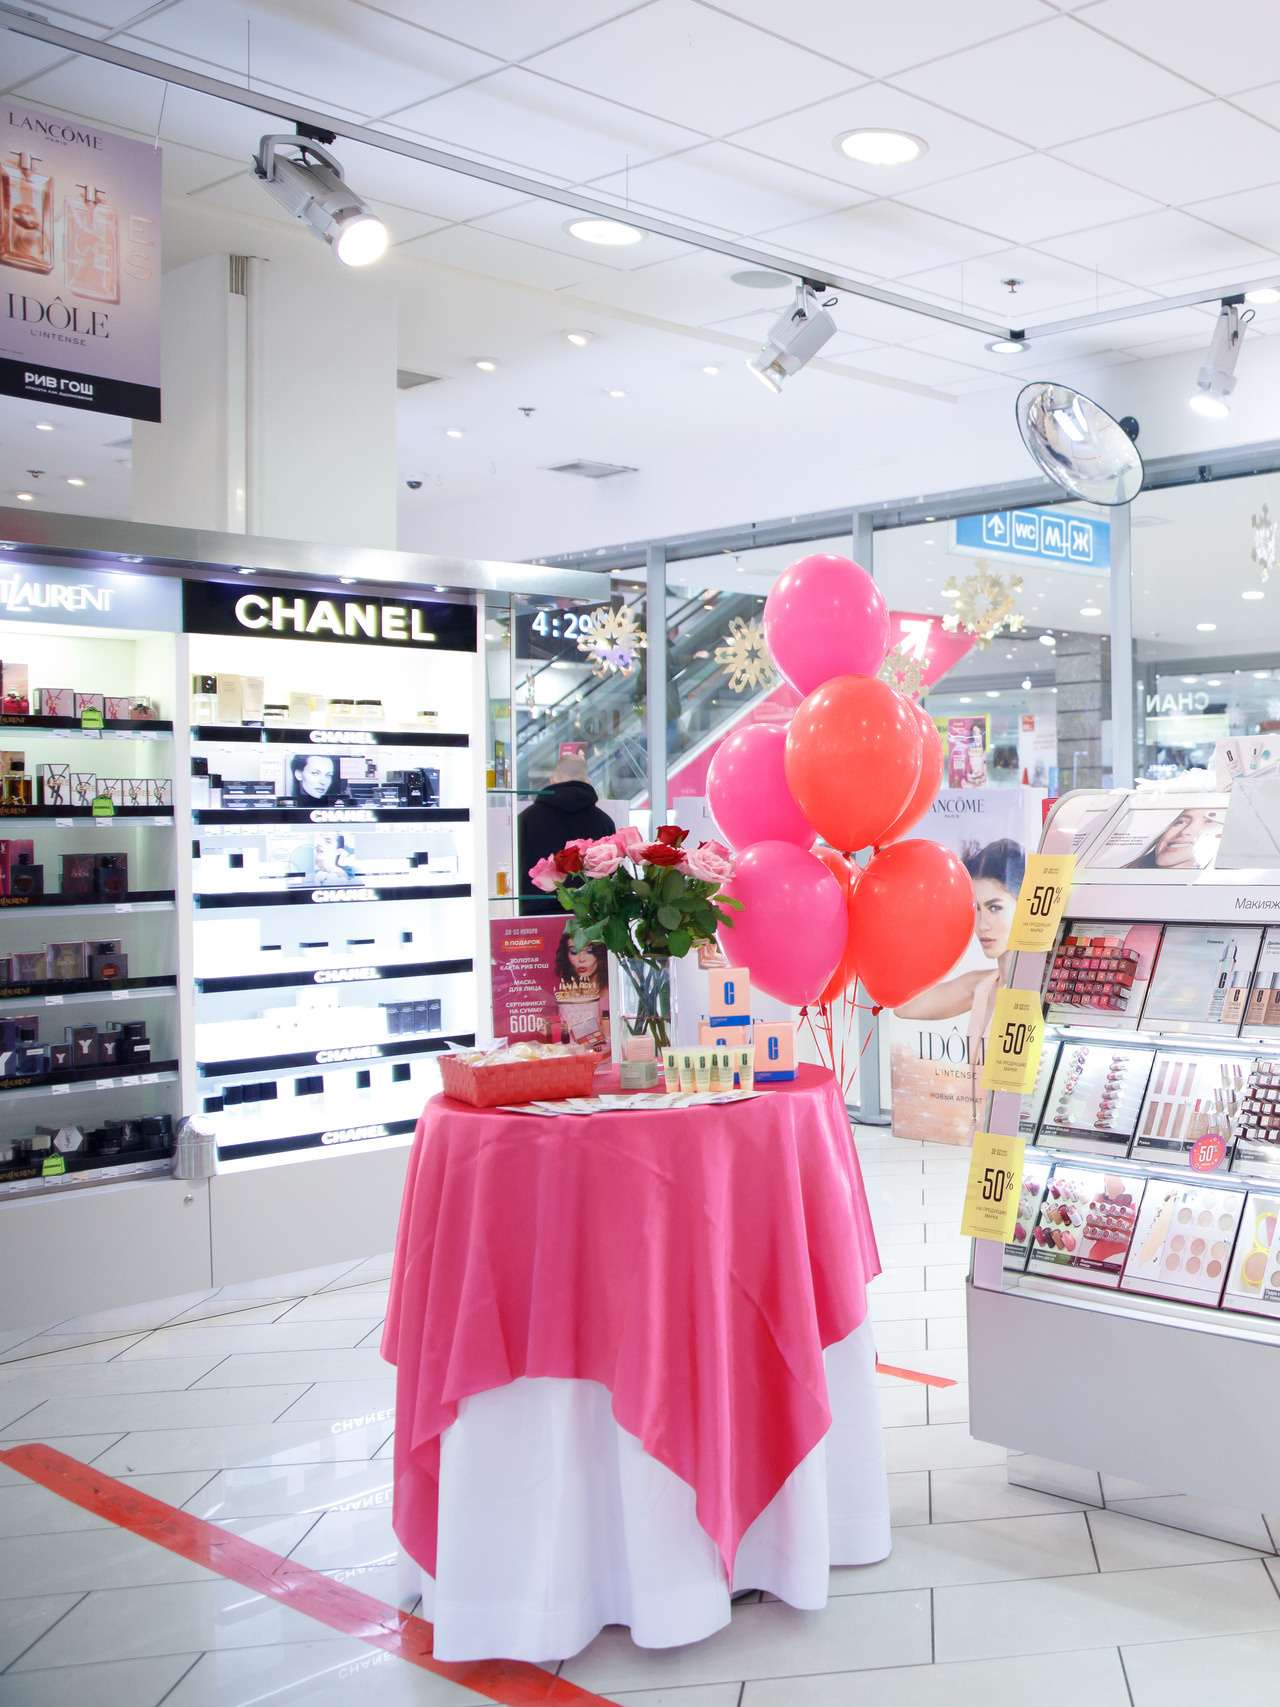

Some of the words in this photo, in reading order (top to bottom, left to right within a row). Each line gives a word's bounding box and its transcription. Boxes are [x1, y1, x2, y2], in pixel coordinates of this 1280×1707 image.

[9, 112, 103, 150] LANCÔME
[8, 293, 110, 339] IDÔLE
[24, 372, 58, 389] РИВ
[60, 379, 94, 396] ГОШ
[1016, 522, 1036, 540] WC
[235, 594, 436, 642] CHANEL
[310, 729, 376, 744] CHANEL
[930, 796, 985, 813] ANCÔME
[310, 809, 377, 823] CHANEL
[311, 889, 378, 903] CHANEL
[313, 967, 381, 984] CHANEL
[316, 1045, 382, 1063] CHANEL
[321, 1125, 388, 1145] CHANEL
